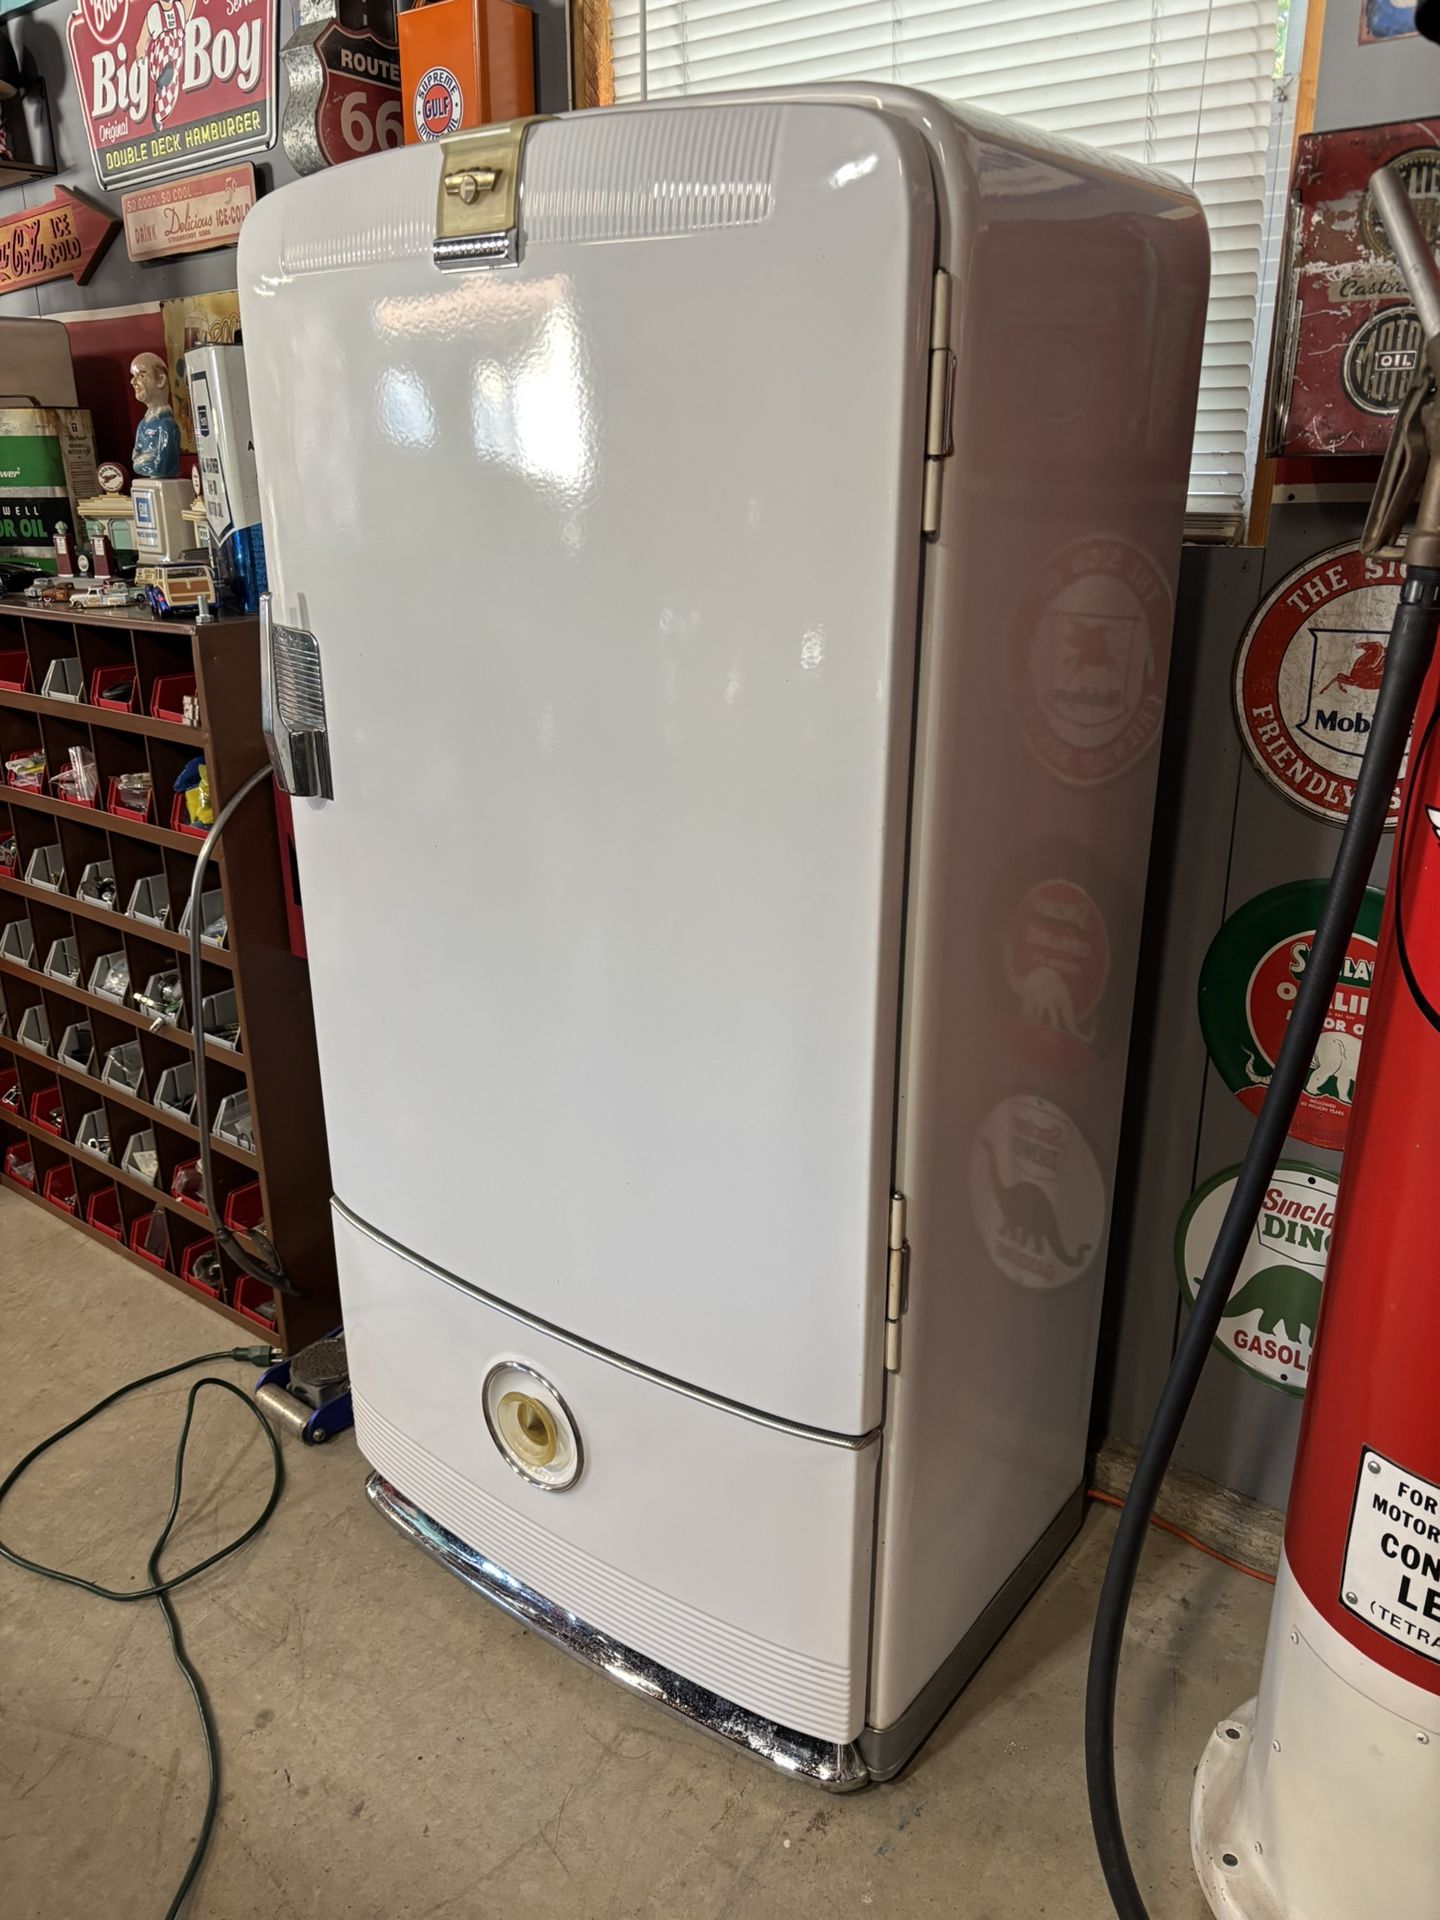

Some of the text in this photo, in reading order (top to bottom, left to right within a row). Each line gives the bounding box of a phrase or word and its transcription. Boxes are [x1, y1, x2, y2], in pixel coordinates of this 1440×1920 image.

[92, 16, 262, 122] Big Boy
[340, 48, 400, 82] ROUTE
[418, 72, 457, 99] SUPREME
[340, 91, 404, 152] 66
[425, 96, 450, 120] GULF
[99, 117, 129, 143] Original
[106, 110, 261, 170] DOUBLE DECK HAMBURGER
[127, 200, 137, 212] SO
[161, 191, 172, 204] SO
[50, 214, 72, 239] ICE
[134, 224, 157, 244] DRINK
[164, 203, 213, 236] Delicious
[1380, 355, 1412, 367] OIL
[19, 519, 48, 537] OIL
[1287, 565, 1349, 613] THE
[1262, 1213, 1332, 1252] DIN
[1397, 1481, 1438, 1515] FOR
[1372, 1493, 1440, 1543] MOTOR
